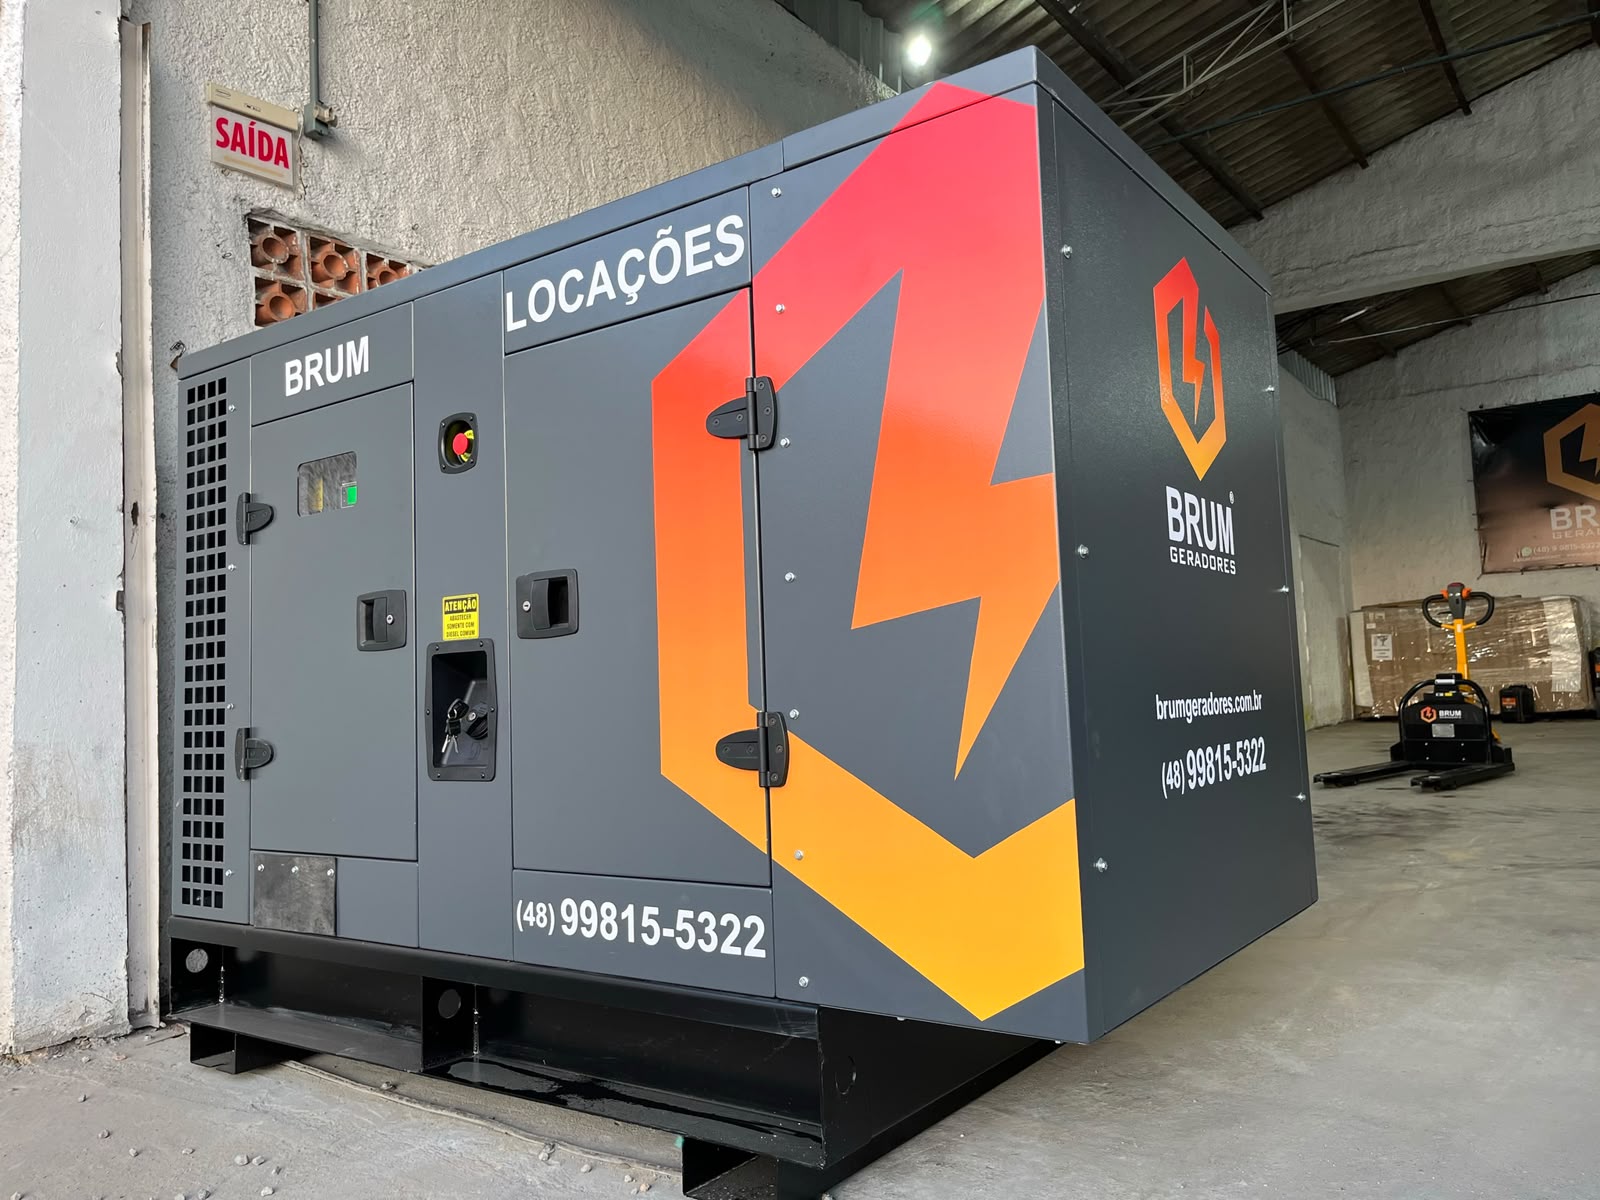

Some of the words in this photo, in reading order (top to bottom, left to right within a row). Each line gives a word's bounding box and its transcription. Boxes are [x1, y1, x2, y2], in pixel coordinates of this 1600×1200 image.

[216, 117, 290, 170] SAÍDA
[506, 214, 745, 333] LOCAÇÕES
[285, 335, 369, 397] BRUM
[1166, 485, 1235, 556] BRUM
[1169, 545, 1236, 575] GERADORES
[445, 598, 476, 612] ATENÇÃO
[1155, 689, 1263, 724] brumgeradores.com.br
[1161, 758, 1185, 799] (48)
[1186, 736, 1267, 790] 99815-5322
[516, 899, 556, 936] (48)
[560, 897, 767, 959] 99815-5322
